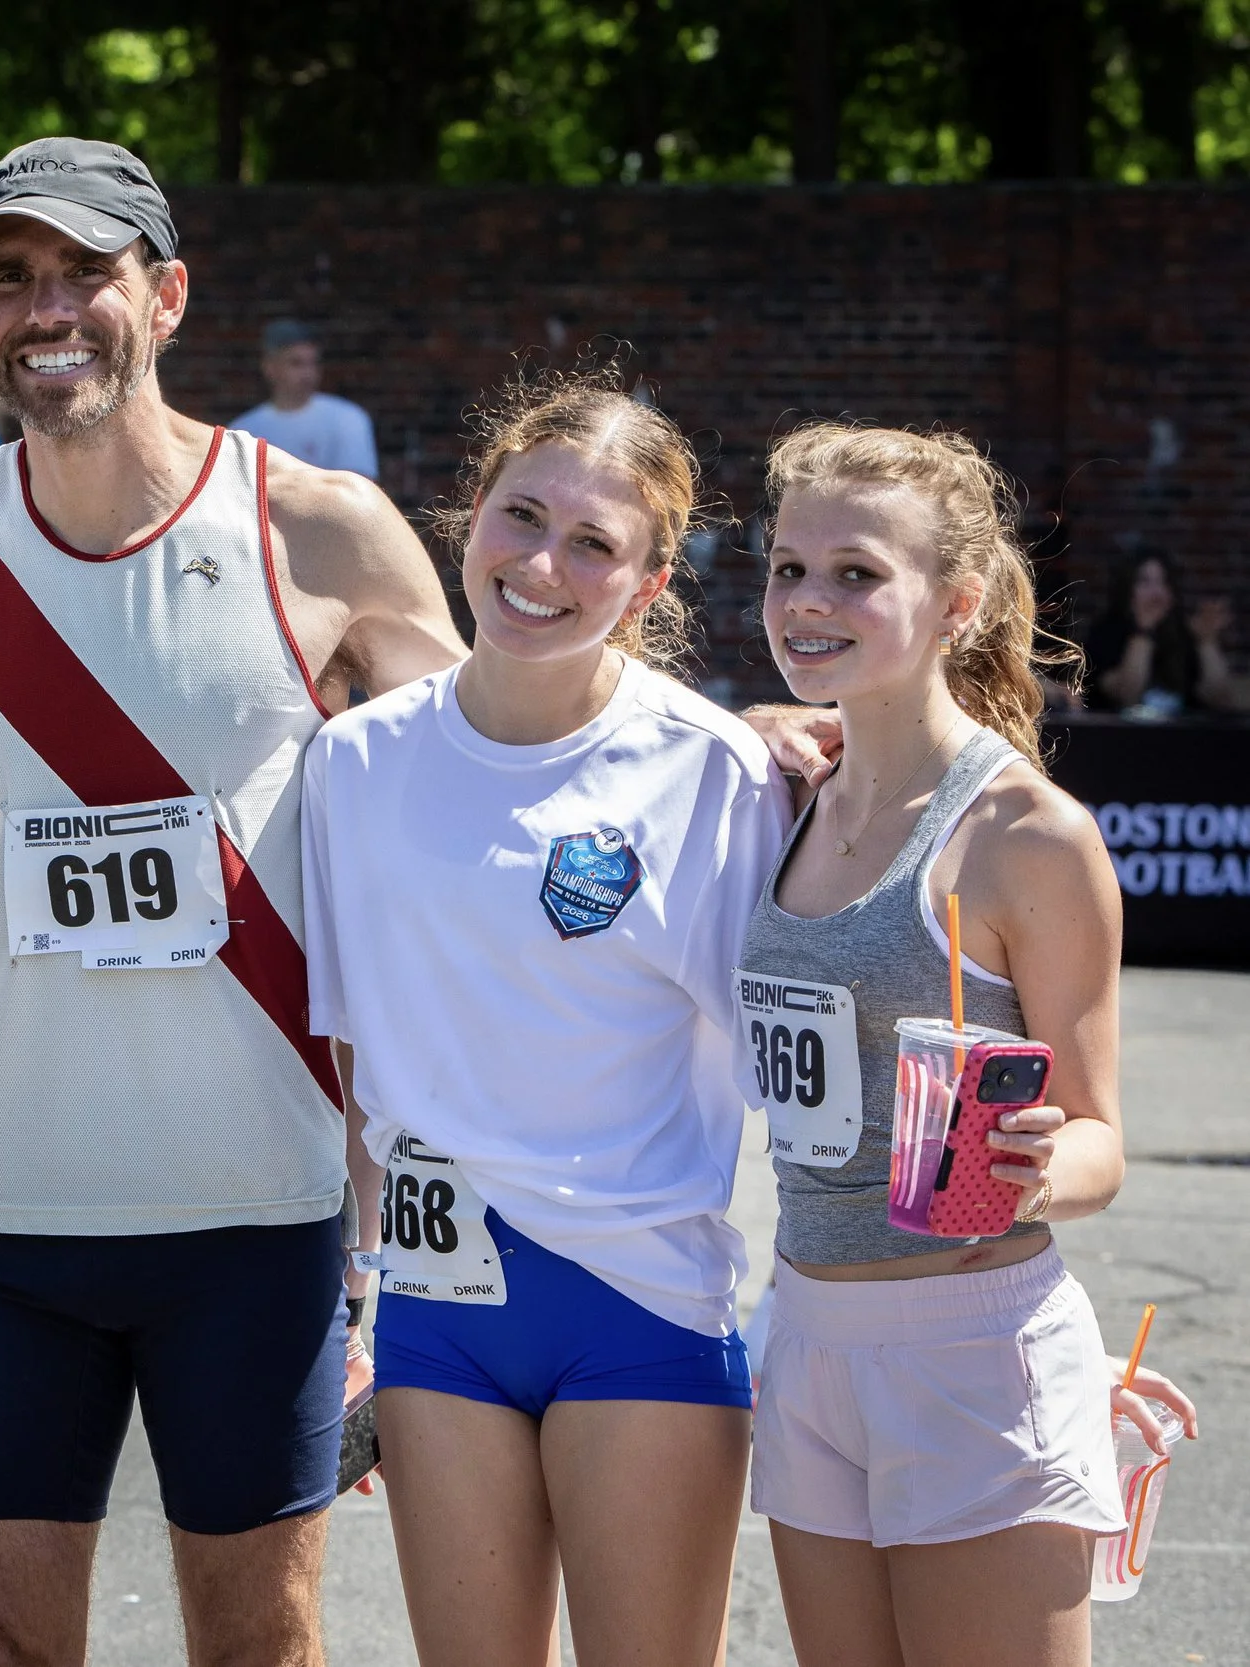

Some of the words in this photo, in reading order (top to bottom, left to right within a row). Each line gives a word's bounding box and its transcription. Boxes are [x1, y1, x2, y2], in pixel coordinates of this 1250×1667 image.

[25, 808, 163, 840] BIONIC
[1091, 802, 1250, 849] OSTON
[47, 847, 178, 928] 619
[550, 867, 624, 907] CHAMPIONSHIPS
[1113, 852, 1250, 896] OTBA
[561, 904, 590, 921] 2026
[565, 891, 596, 909] NEPSTA
[97, 955, 142, 967] DRINK
[171, 948, 206, 962] DRIN
[741, 978, 817, 1013] BIONIC
[751, 1020, 825, 1108] 369
[774, 1137, 793, 1153] DRINK
[811, 1144, 849, 1158] DRINK
[381, 1167, 459, 1254] 368
[393, 1281, 431, 1294] DRINK
[453, 1284, 496, 1296] DRINK
